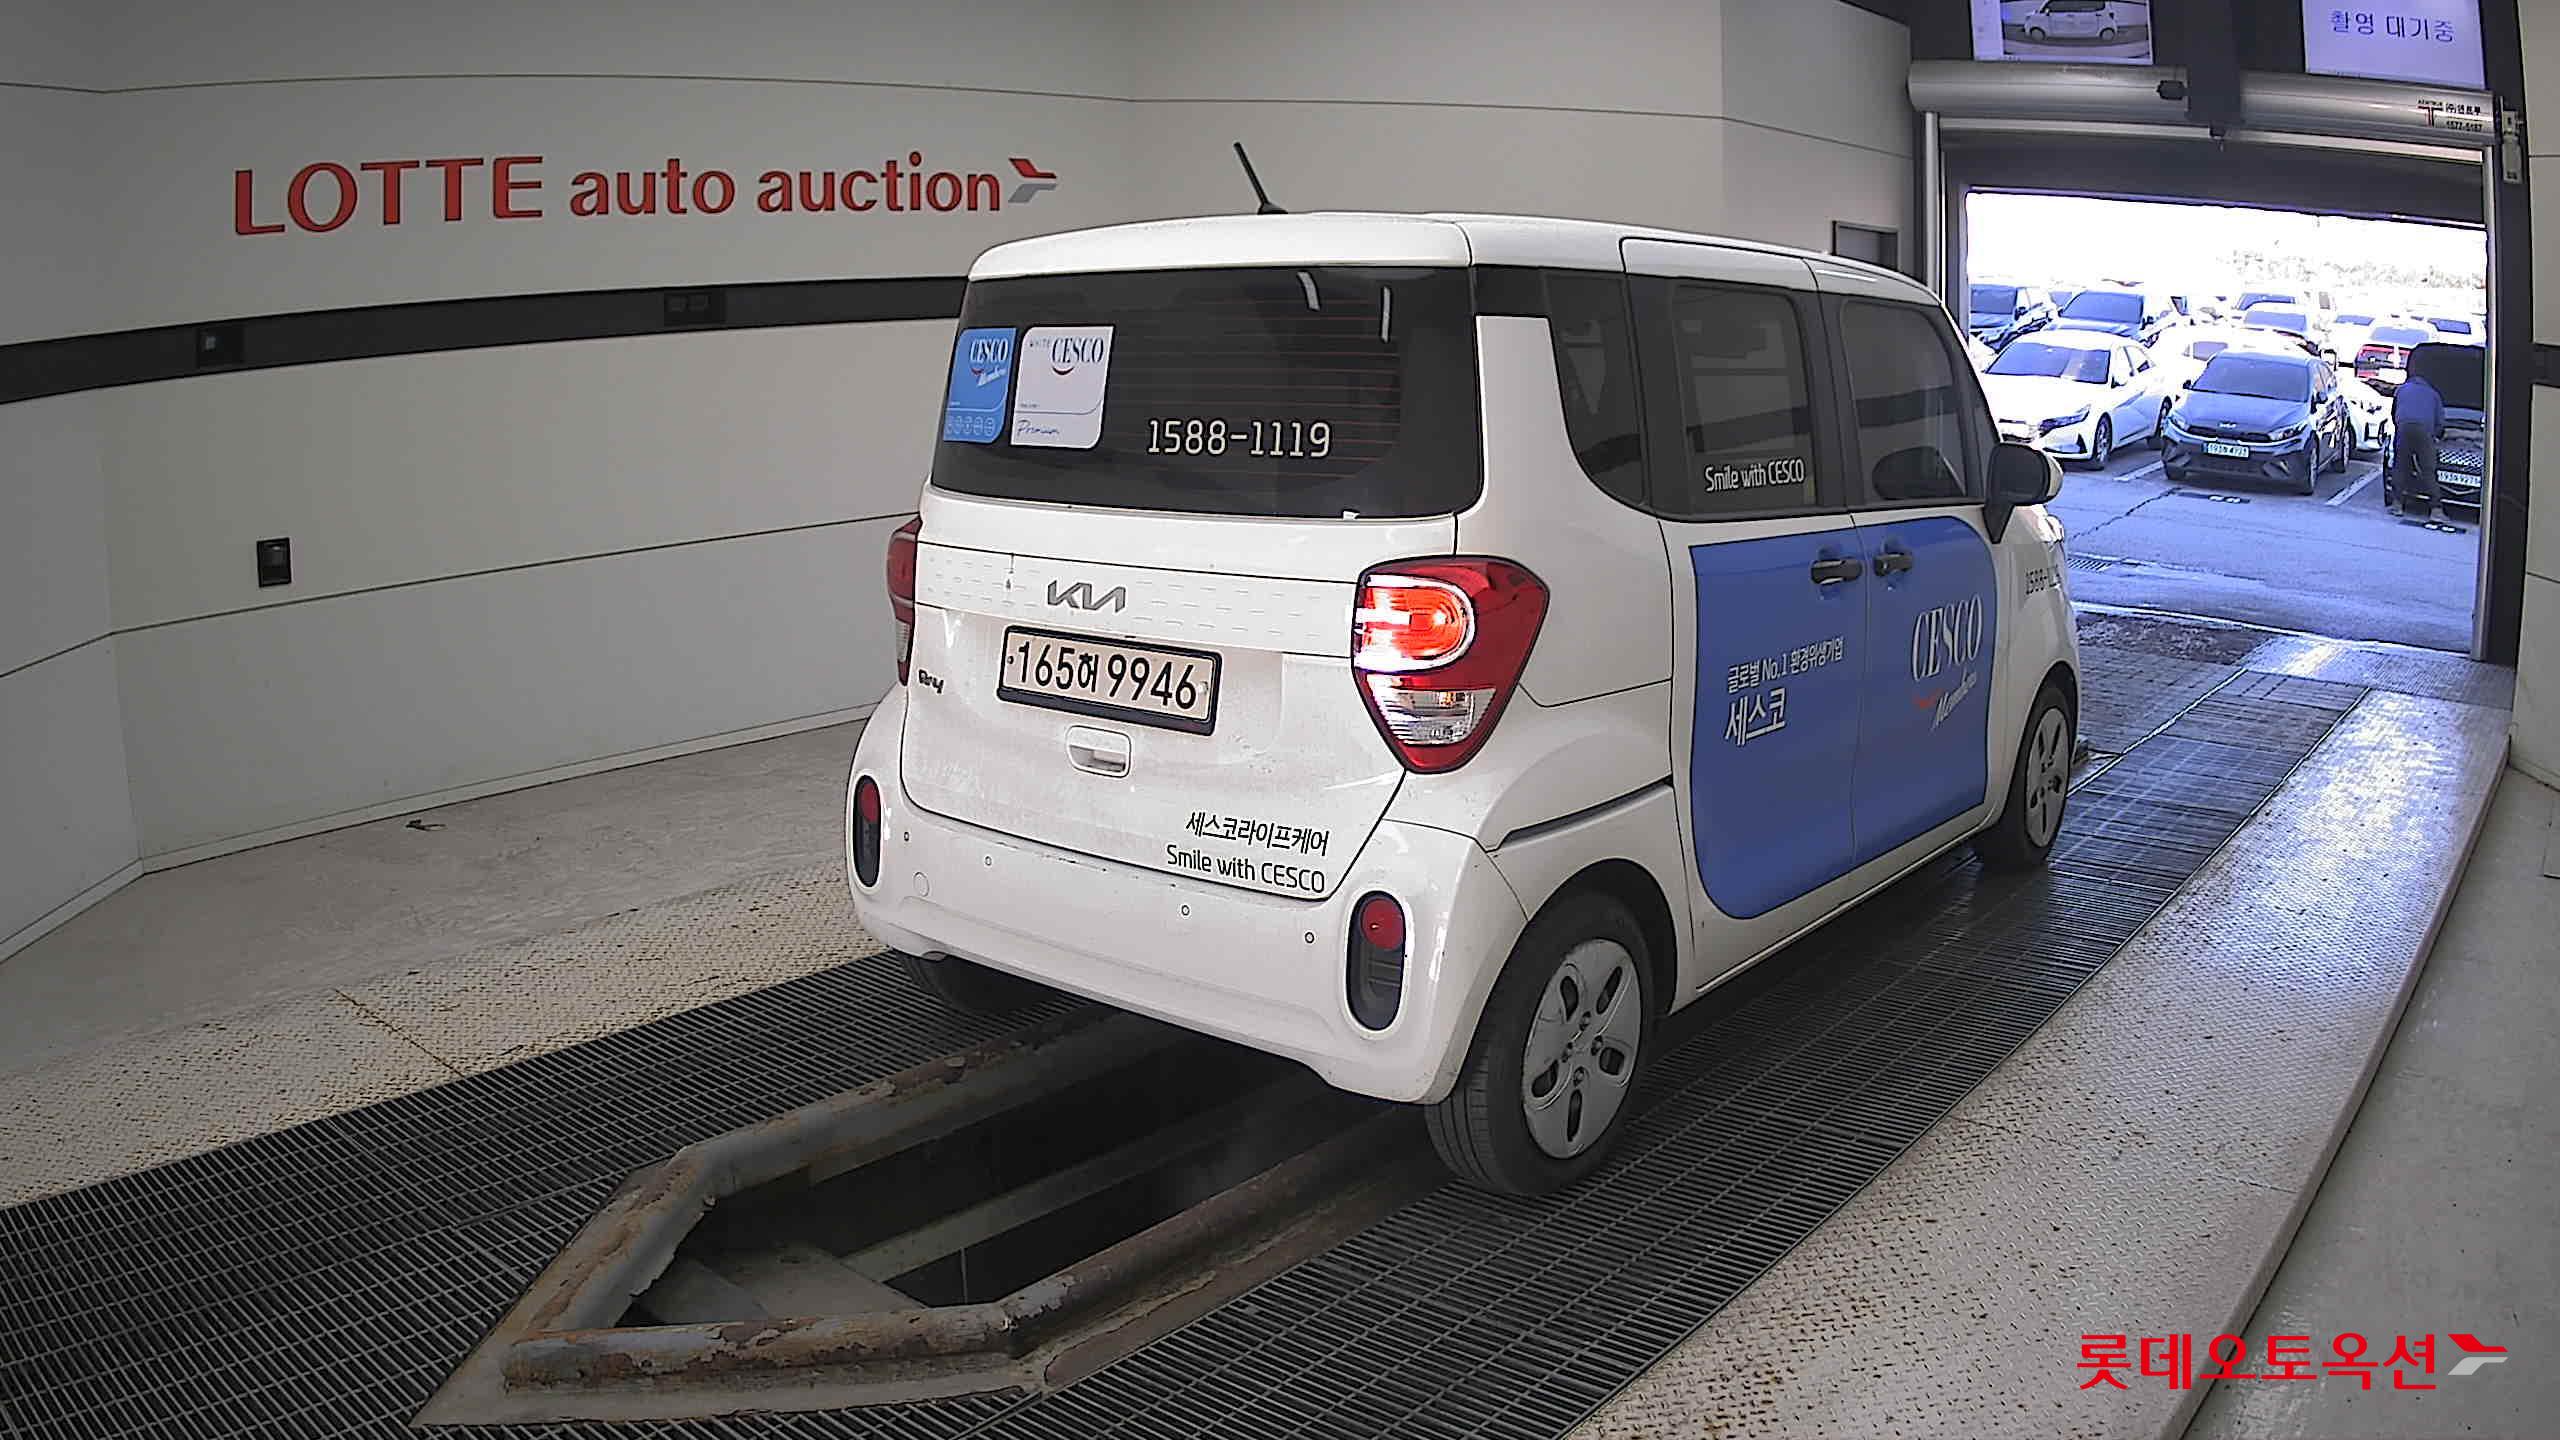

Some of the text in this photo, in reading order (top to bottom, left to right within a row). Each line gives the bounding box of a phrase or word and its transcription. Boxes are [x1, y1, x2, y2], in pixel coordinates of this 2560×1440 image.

[2331, 10, 2454, 43] 촬영 대기중
[234, 152, 1002, 236] LOTTE auto auction
[970, 337, 1009, 363] CESCO
[1052, 337, 1104, 363] CESCO
[1148, 419, 1331, 458] 1588-1119
[1705, 458, 1805, 492] Smile with CESCO
[1911, 593, 1983, 682] CESCO
[1017, 640, 1198, 710] 165허 9946
[1727, 658, 1760, 694] 글로벌
[1762, 653, 1789, 681] No.1
[1724, 686, 1786, 746] 세스코
[1185, 811, 1330, 857] 세스코라이프케어
[1166, 844, 1326, 894] Smile with CESCO
